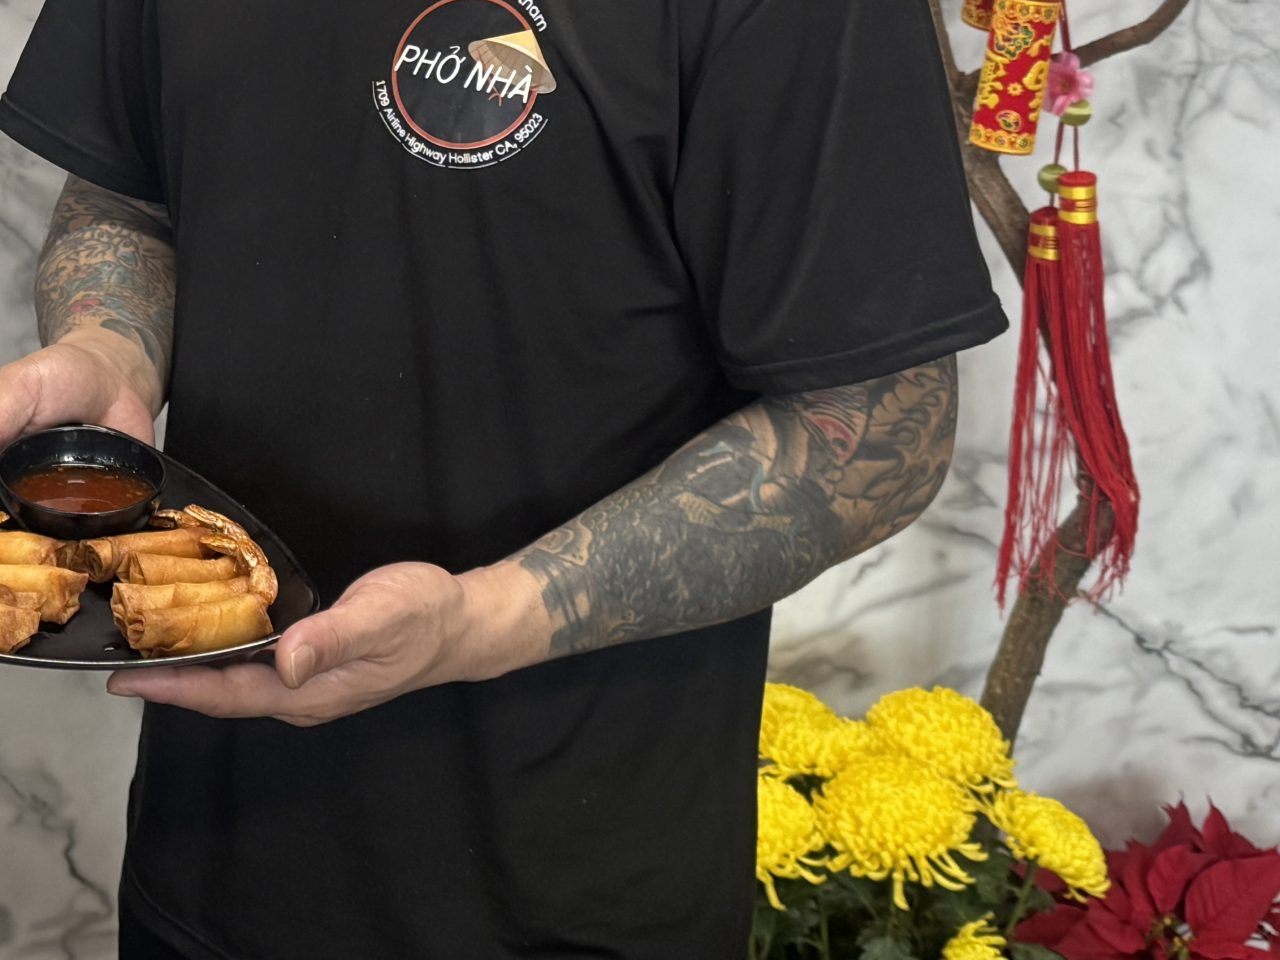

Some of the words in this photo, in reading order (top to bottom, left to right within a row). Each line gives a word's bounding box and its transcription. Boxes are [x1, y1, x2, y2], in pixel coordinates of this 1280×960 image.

[394, 44, 466, 84] PHỞ
[375, 80, 391, 106] 1709
[384, 108, 405, 137] Airline
[404, 133, 447, 164] Highway
[448, 149, 493, 164] Hollister
[514, 112, 543, 143] 95023
